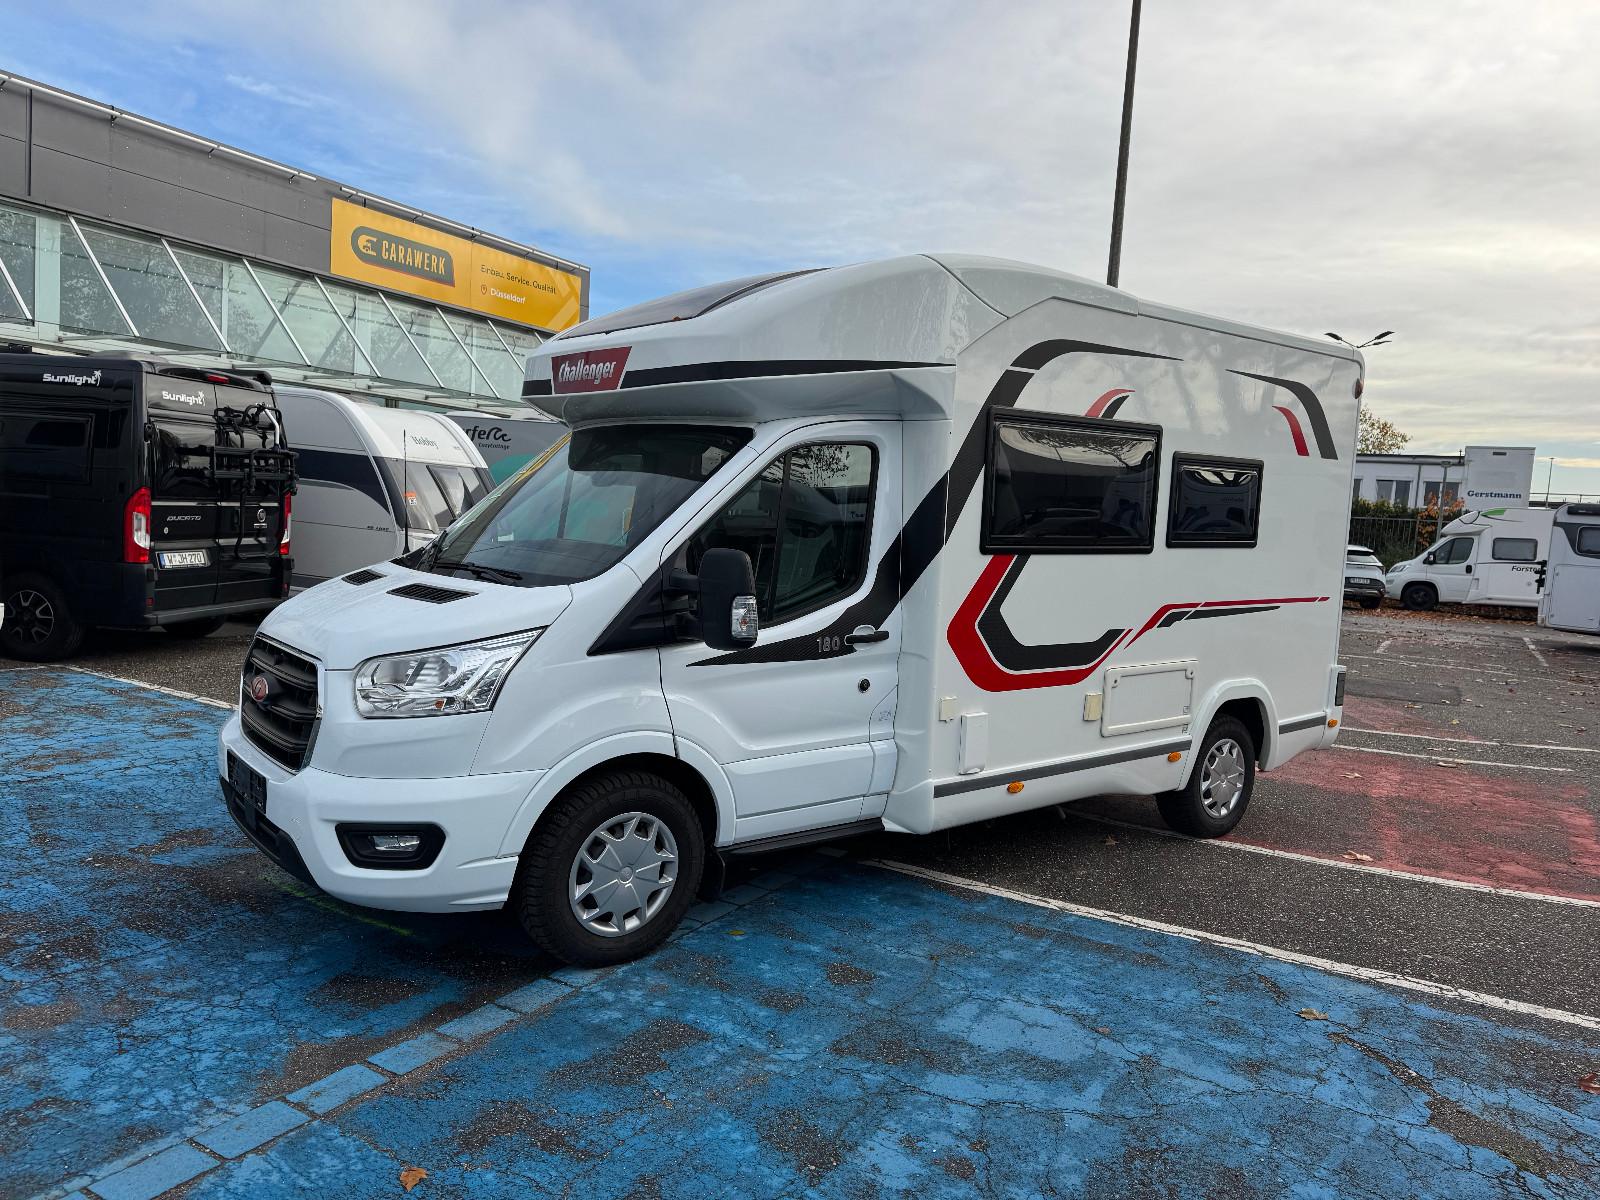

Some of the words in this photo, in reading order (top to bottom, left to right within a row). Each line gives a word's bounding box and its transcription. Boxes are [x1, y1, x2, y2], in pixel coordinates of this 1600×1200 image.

[381, 240, 446, 276] CARAWERK
[506, 272, 532, 287] Service.
[490, 287, 526, 305] Düsseldorf
[42, 373, 97, 386] Sunlight
[558, 358, 617, 385] Challenger
[162, 390, 203, 406] Sunlight
[816, 635, 841, 652] 180
